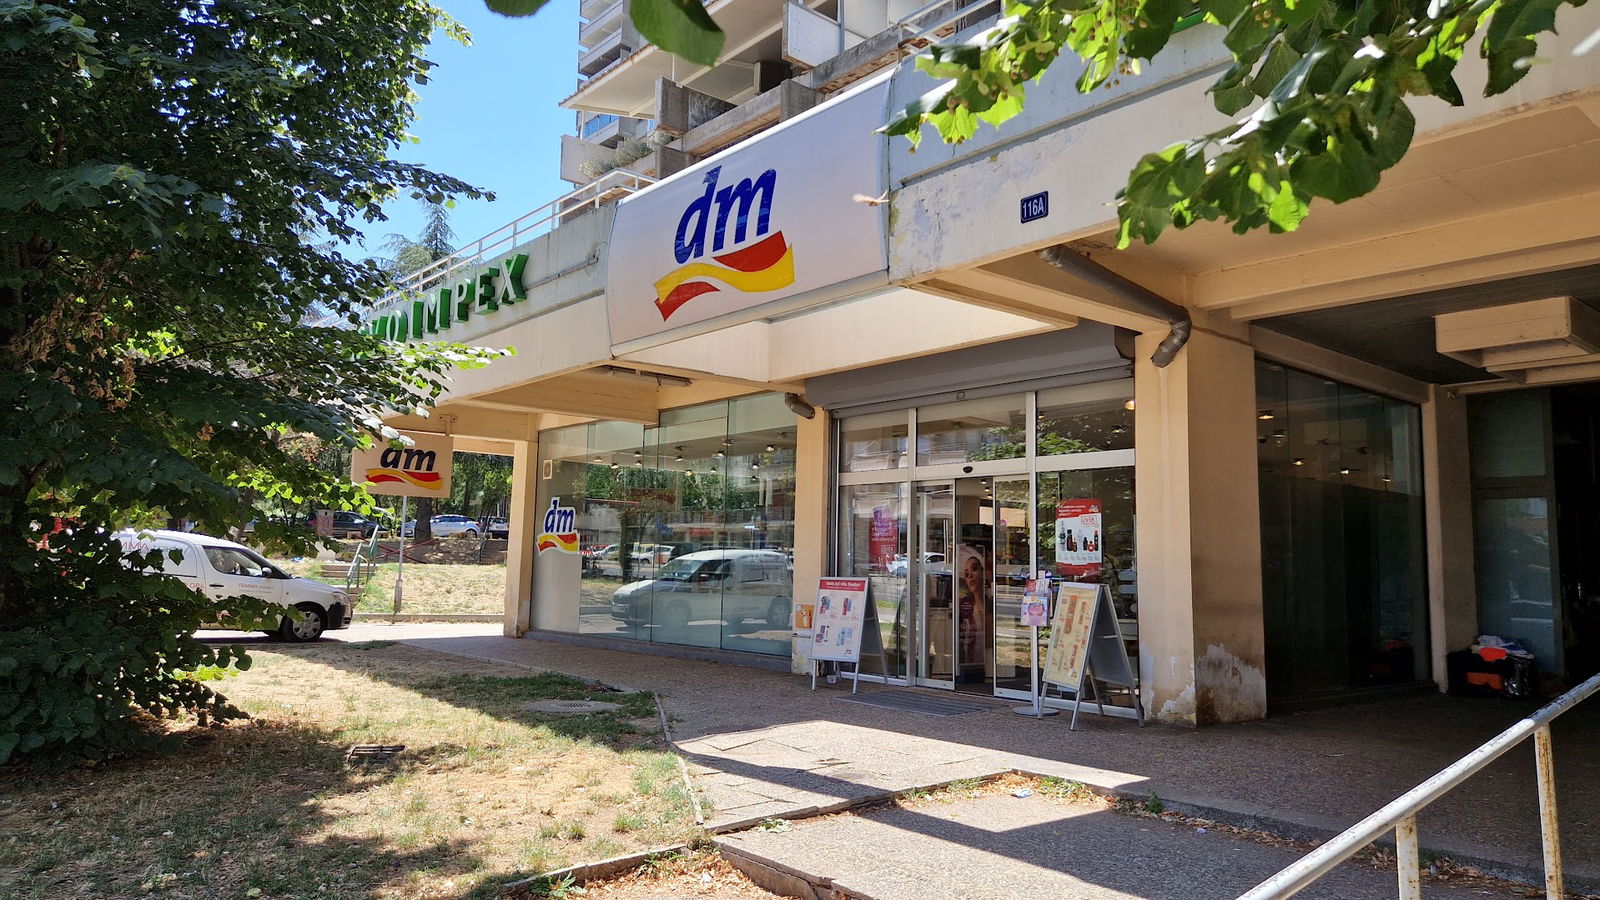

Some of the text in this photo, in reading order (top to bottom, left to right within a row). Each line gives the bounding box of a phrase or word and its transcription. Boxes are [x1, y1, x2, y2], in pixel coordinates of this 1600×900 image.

[674, 164, 777, 264] dm
[1022, 196, 1045, 219] 116A
[544, 499, 575, 533] dm
